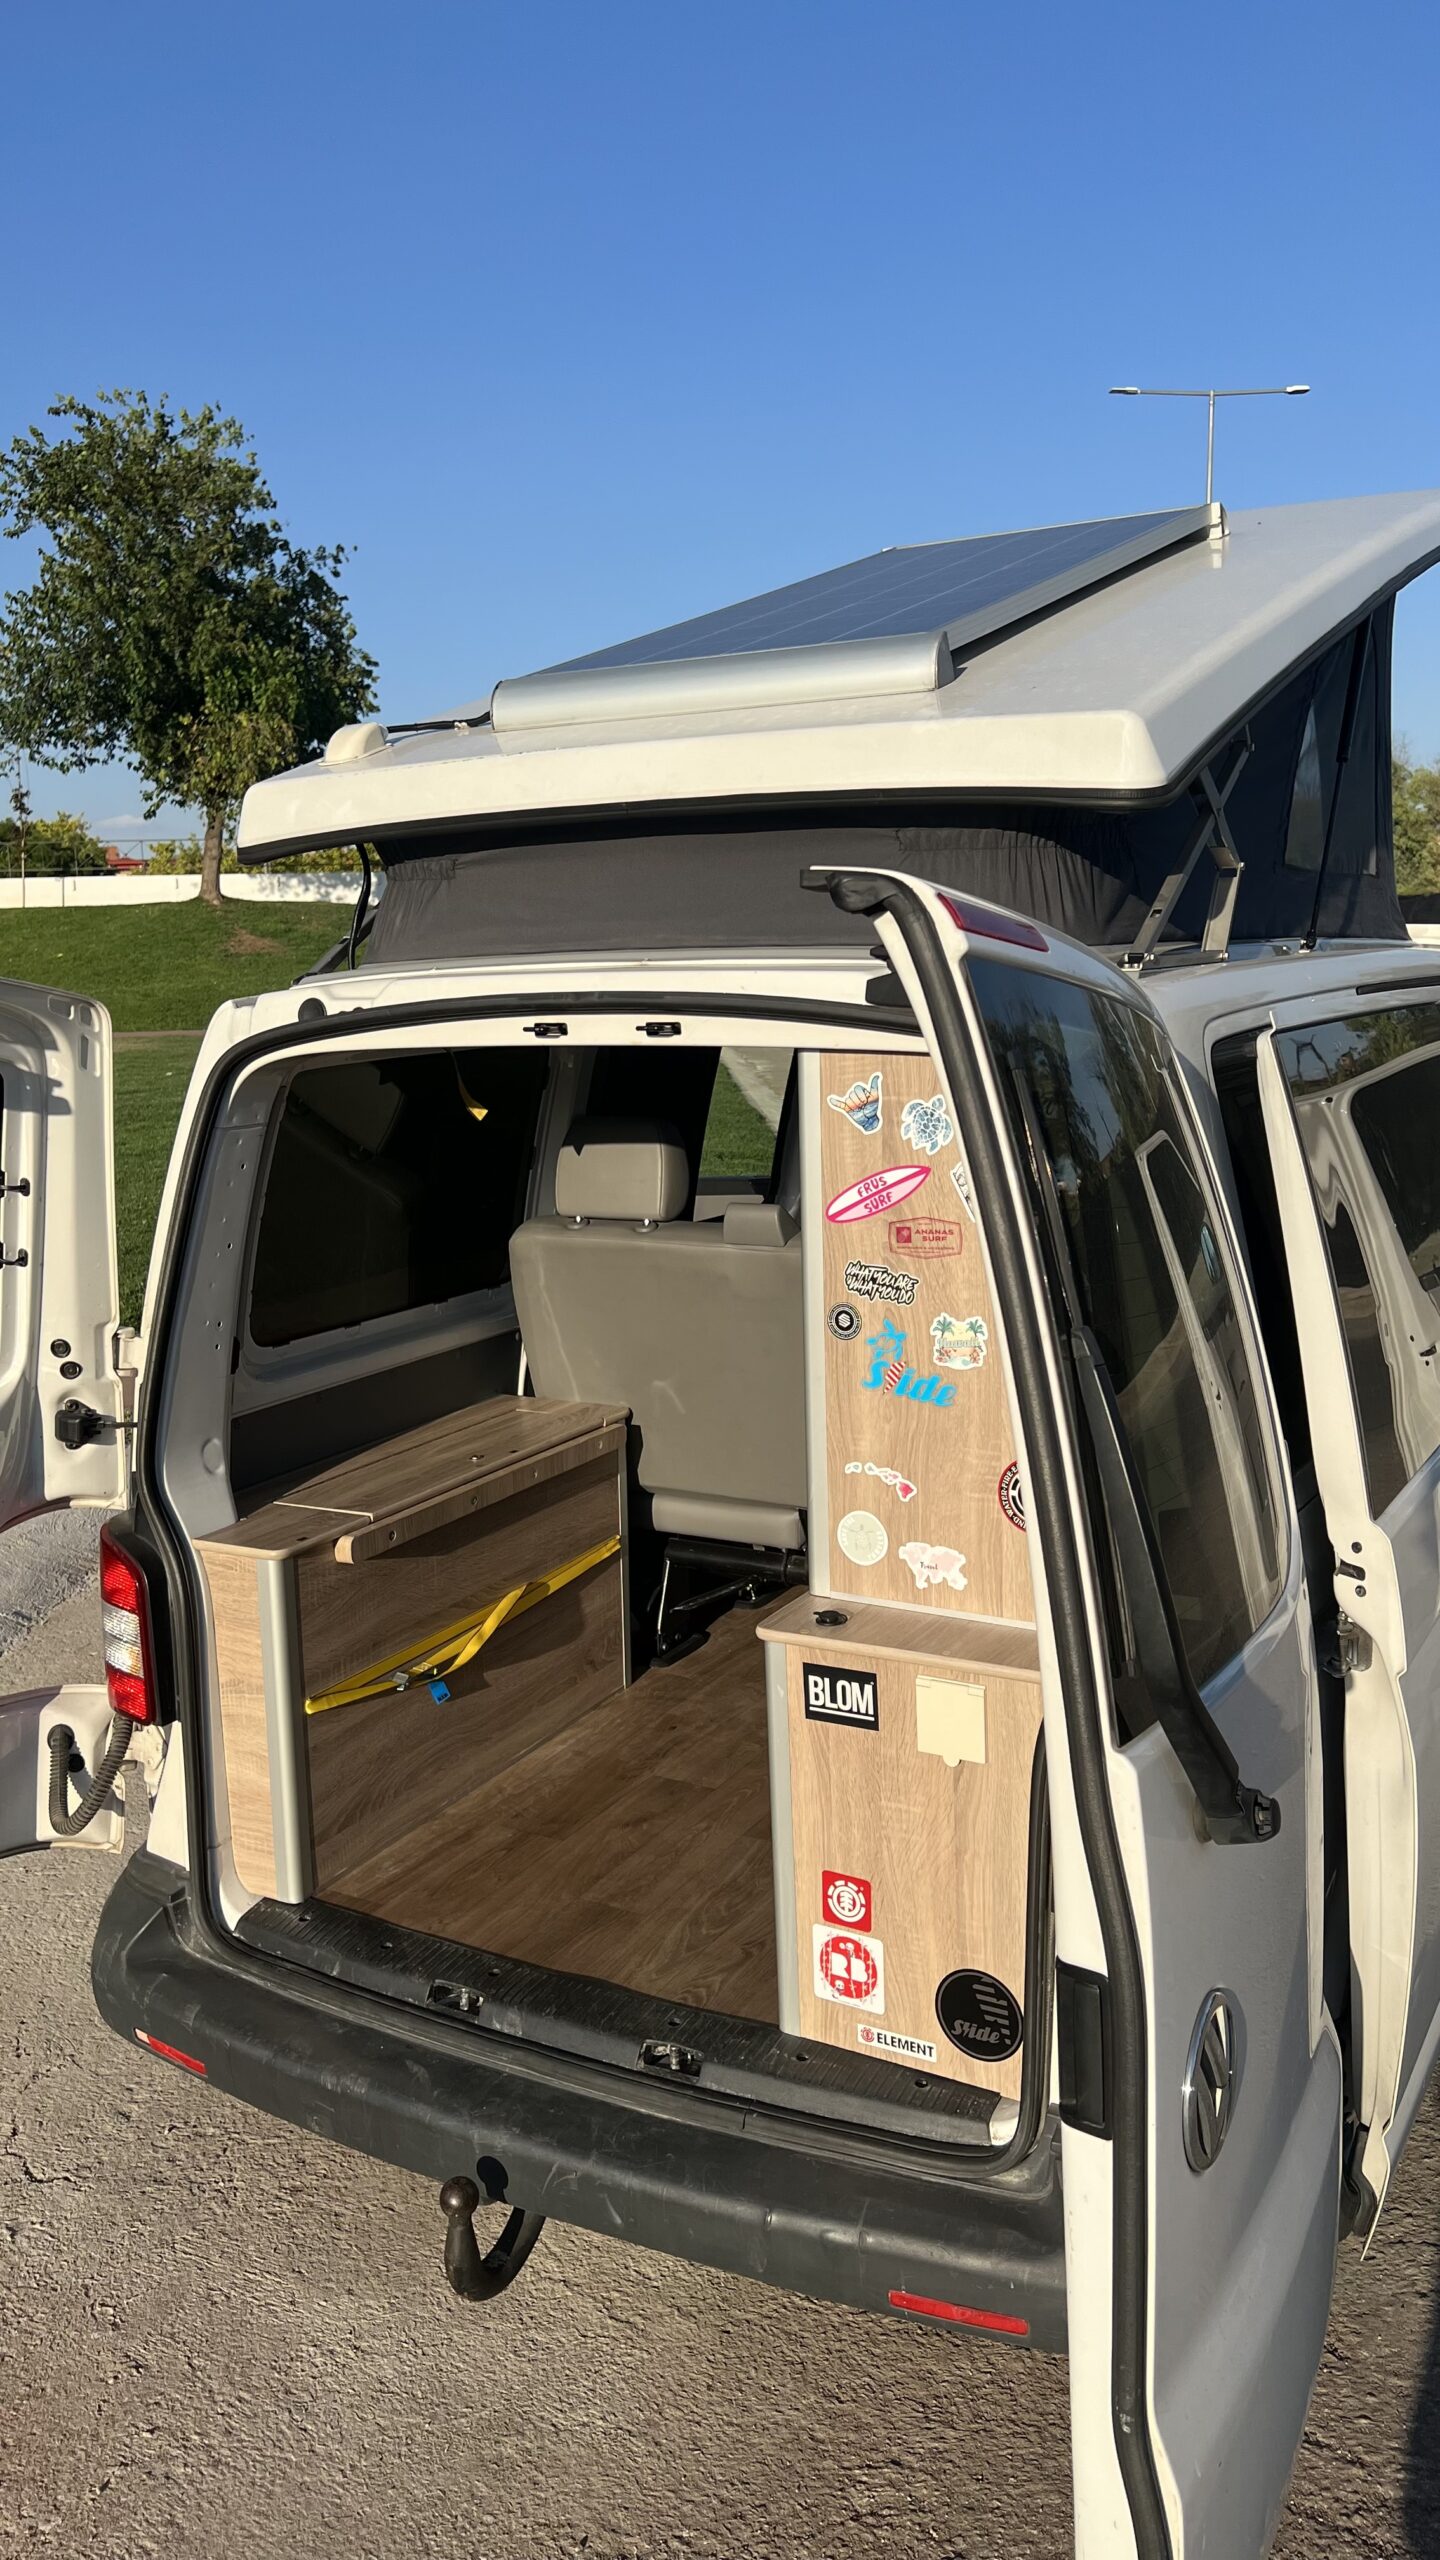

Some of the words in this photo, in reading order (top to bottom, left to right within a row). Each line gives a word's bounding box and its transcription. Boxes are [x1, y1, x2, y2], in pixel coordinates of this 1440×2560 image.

[857, 1176, 887, 1197] FRUS
[864, 1192, 892, 1213] SURF
[808, 1674, 874, 1716] BLOM
[876, 2032, 934, 2058] ELEMENT
